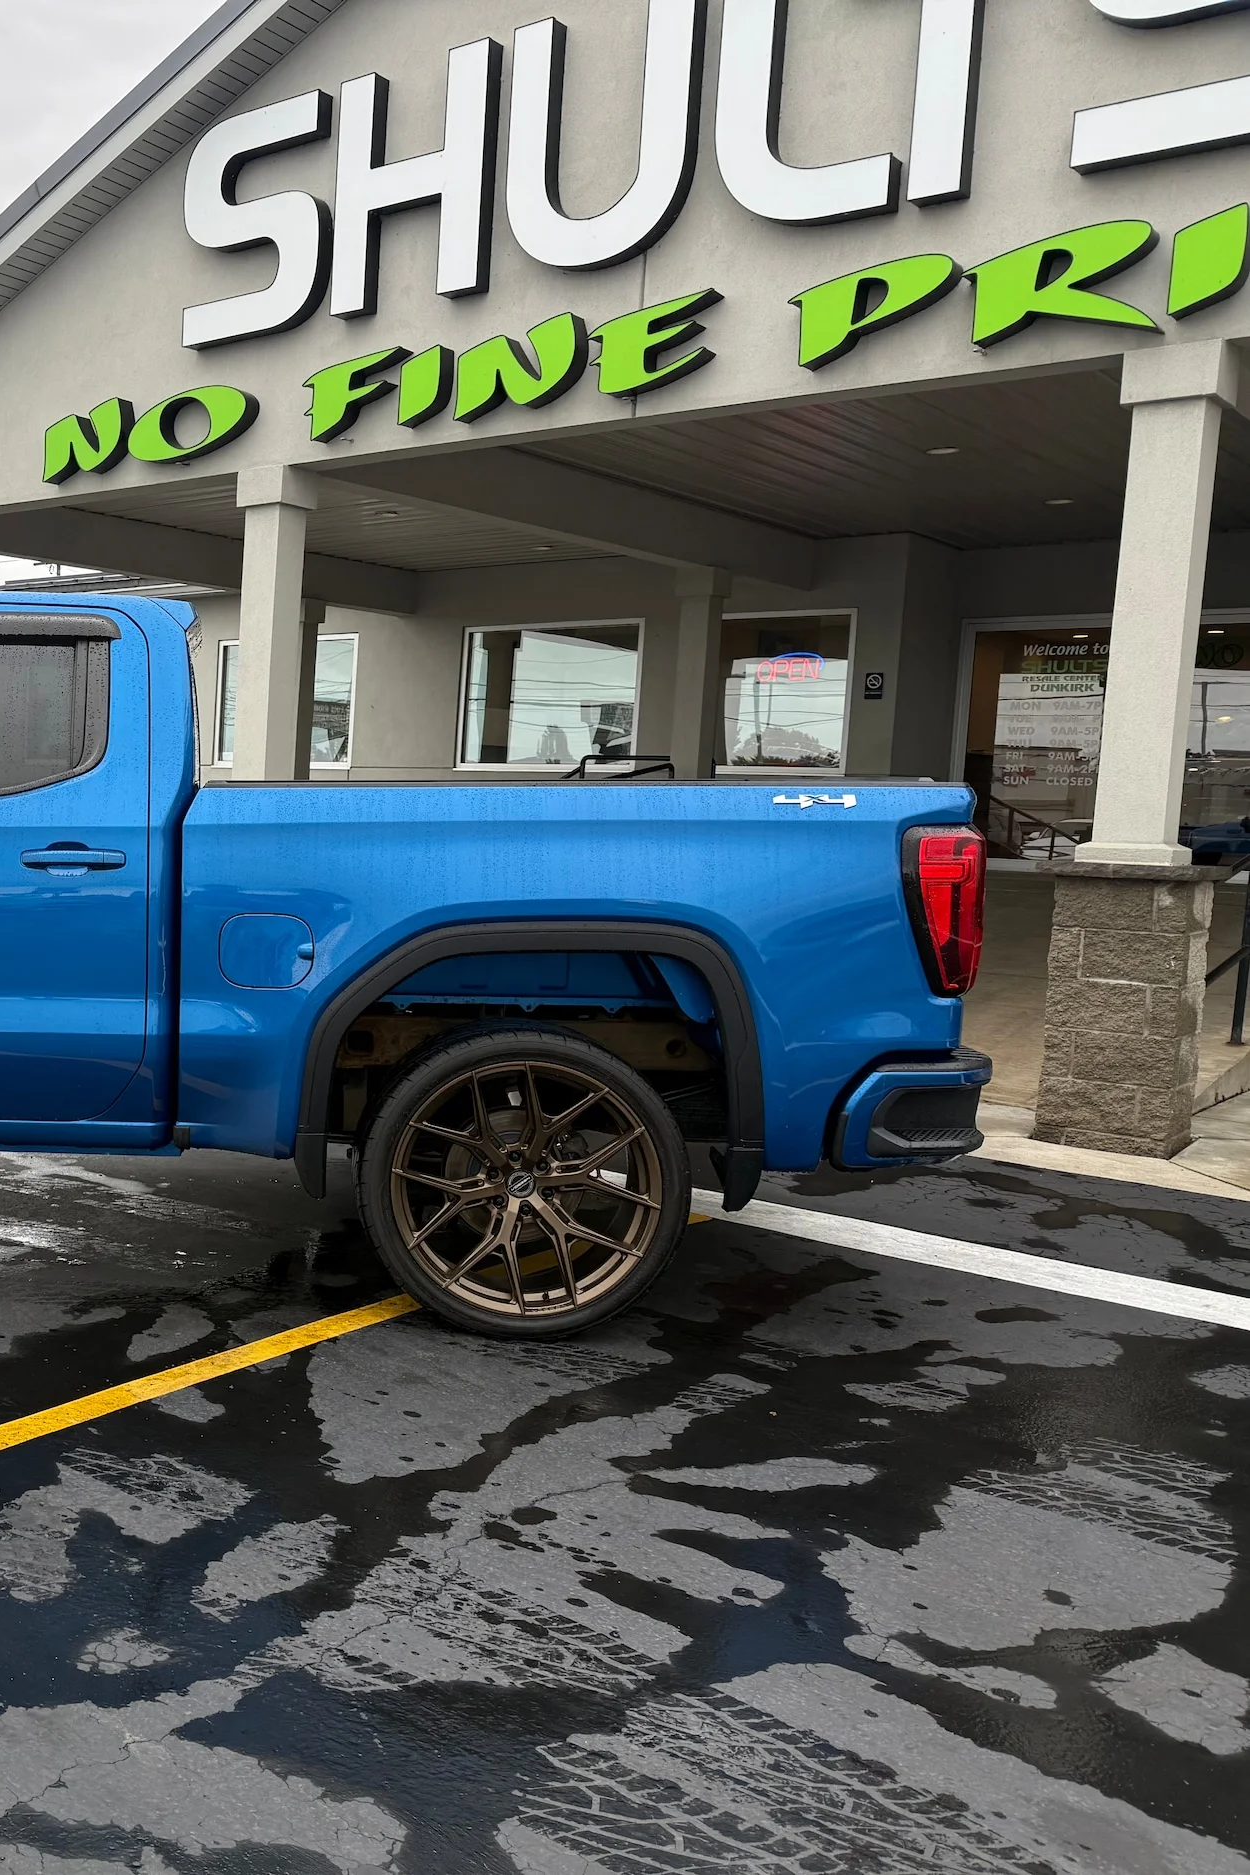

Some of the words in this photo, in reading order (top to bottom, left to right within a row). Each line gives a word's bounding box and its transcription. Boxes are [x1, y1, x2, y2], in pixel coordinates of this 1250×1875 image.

[42, 385, 260, 484] NO
[303, 288, 725, 443] FINE
[1023, 643, 1088, 656] Welcome
[1093, 643, 1110, 654] to
[757, 658, 821, 683] OPEN
[1021, 659, 1108, 673] SHULTS
[1022, 675, 1061, 683] RESALE
[1030, 684, 1095, 692] DUNKIRK
[1010, 701, 1042, 711] MON
[1052, 701, 1102, 710] 9AM-7P
[1008, 727, 1035, 736] WED
[1050, 727, 1099, 736] 9AM-5P
[1049, 739, 1098, 748] 9AM-5P
[1005, 751, 1023, 760] FRI
[1003, 764, 1026, 773] SAT
[1046, 764, 1098, 773] 9AM-2P
[1003, 776, 1030, 785] SUN
[1046, 777, 1093, 786] CLOSED
